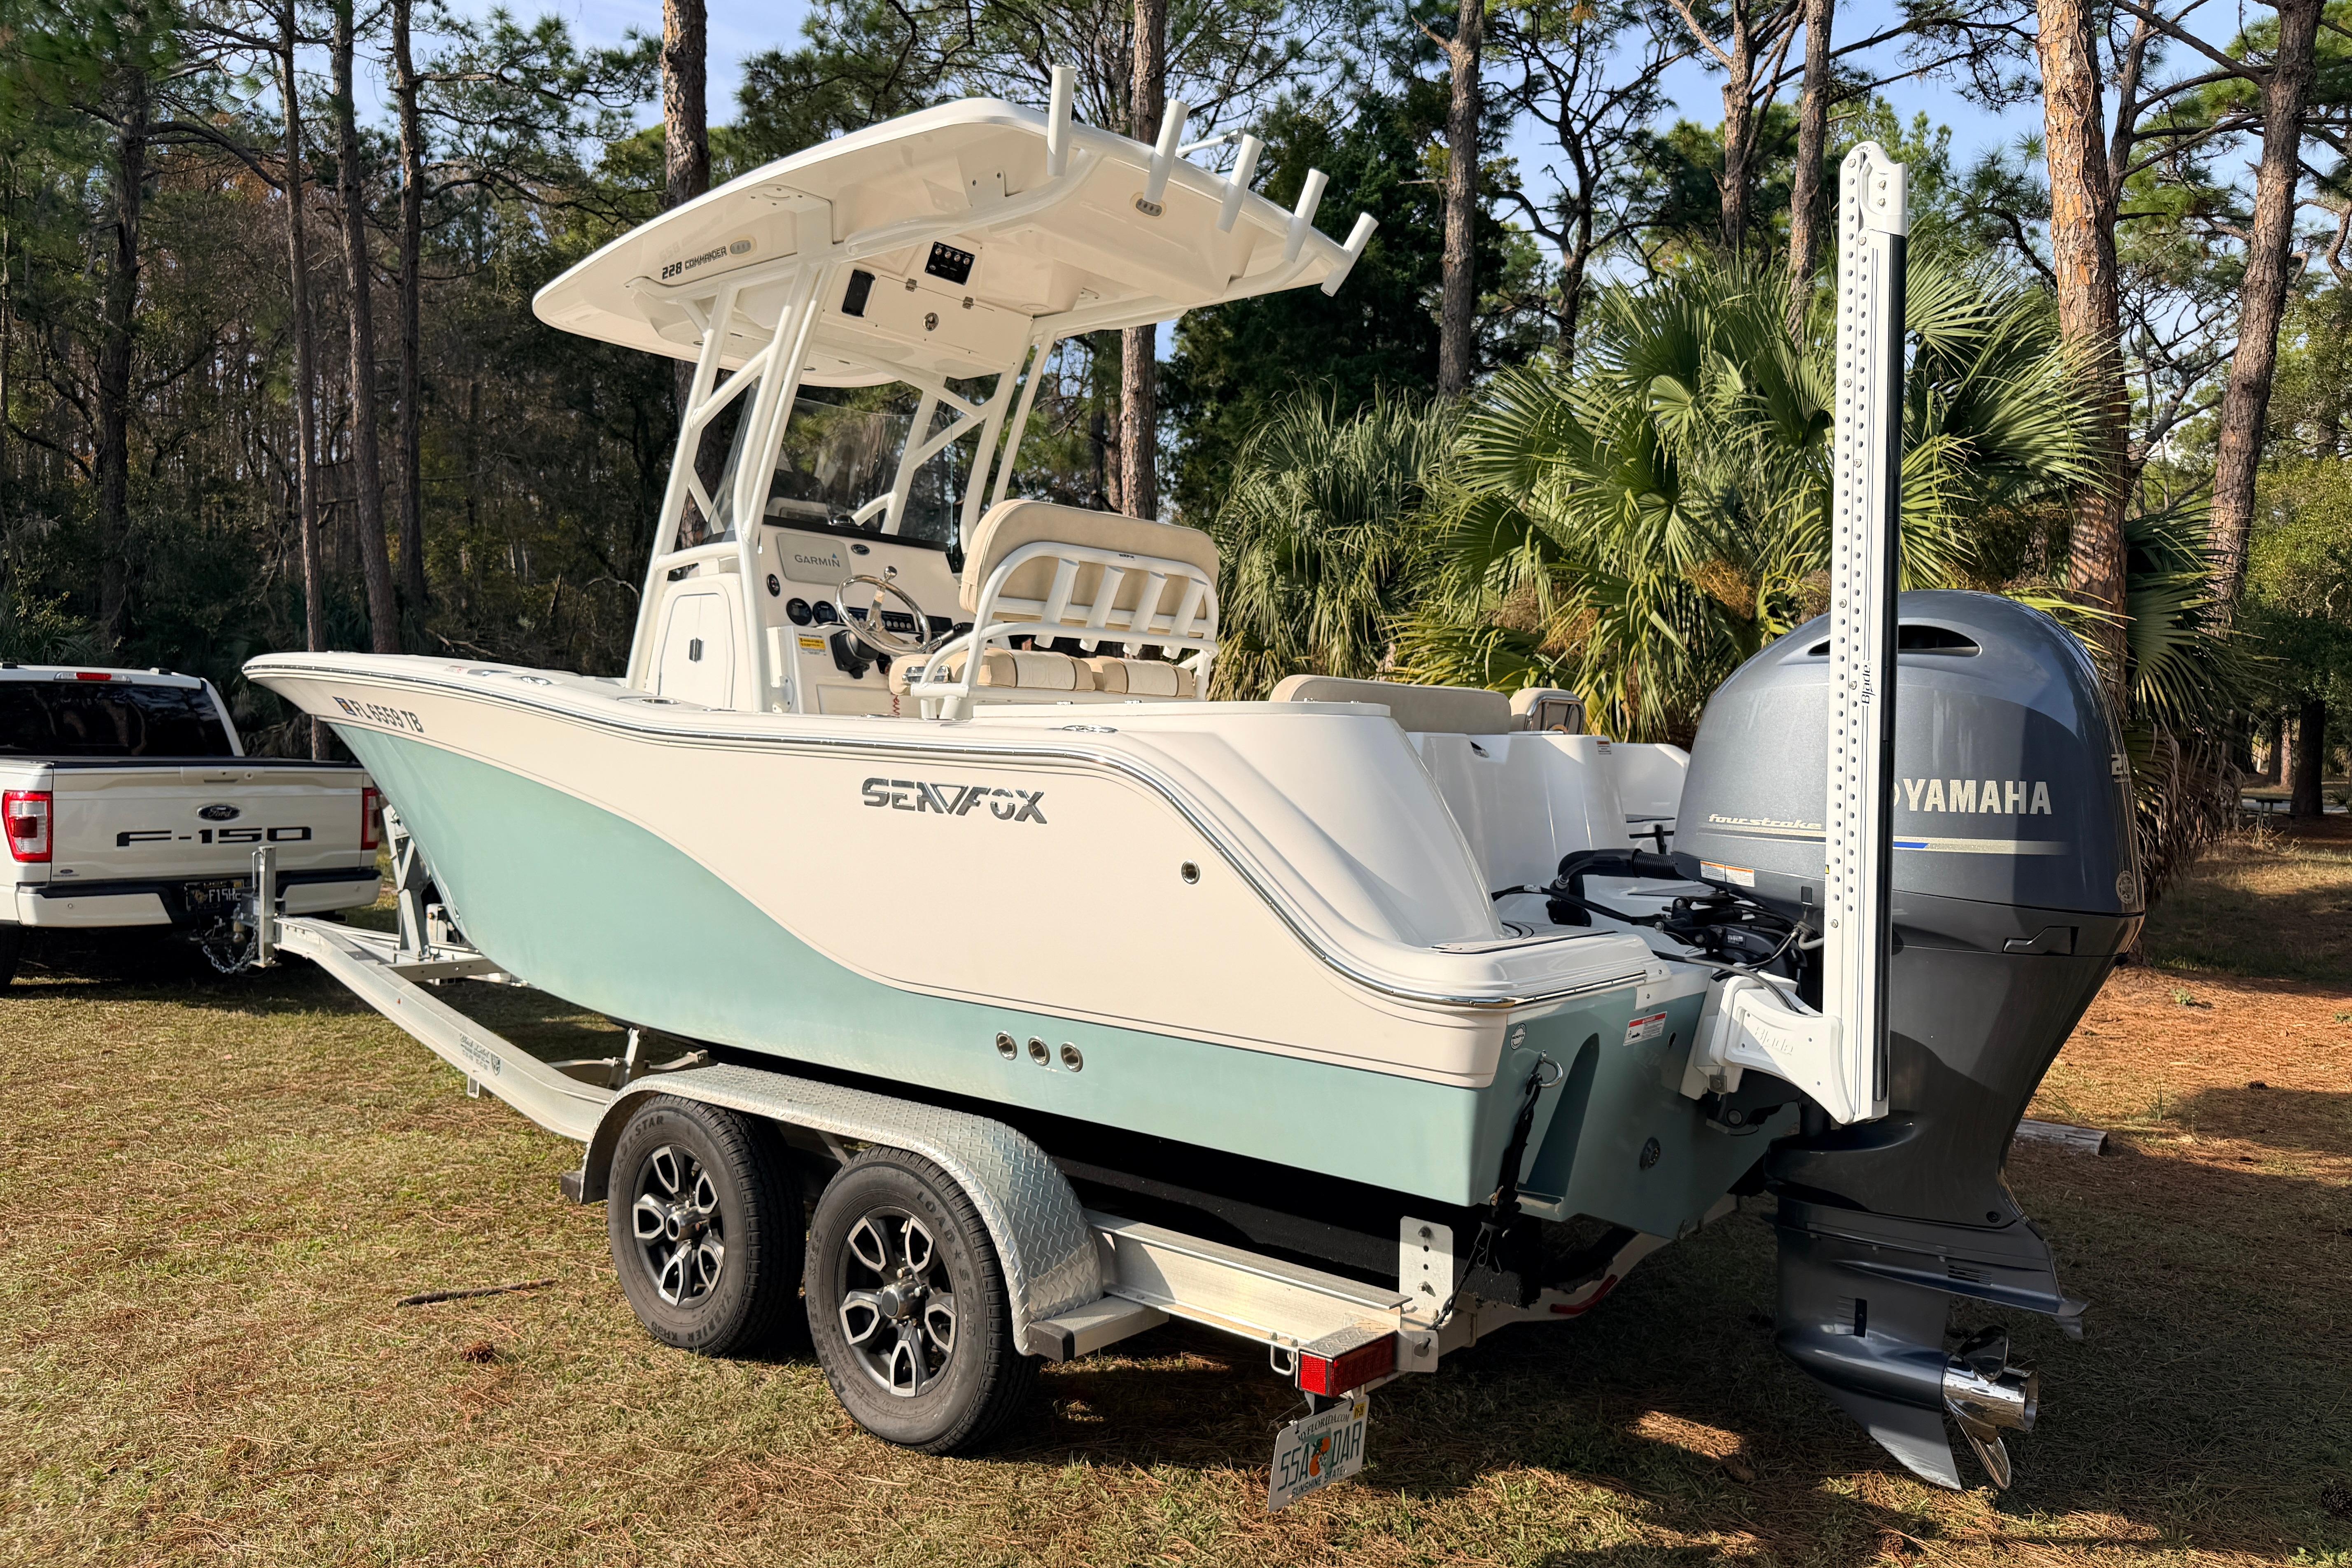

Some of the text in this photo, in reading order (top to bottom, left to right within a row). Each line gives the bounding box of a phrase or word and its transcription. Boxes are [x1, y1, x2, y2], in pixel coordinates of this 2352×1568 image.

[662, 246, 728, 280] 228 COMMANDER
[795, 554, 840, 567] GARMIN
[1861, 665, 1876, 704] Blade
[348, 699, 424, 733] FL 6559 TB
[1902, 778, 2052, 815] YAMAHA
[207, 807, 233, 818] Ford
[117, 826, 311, 847] F-150
[1755, 1027, 1794, 1056] Blade
[635, 1115, 664, 1136] STAR
[916, 1191, 976, 1337] LOAD STAR
[651, 1321, 678, 1342] KR35
[1329, 1421, 1362, 1468] DAR
[1292, 1465, 1344, 1496] SUNSHINE STATE
